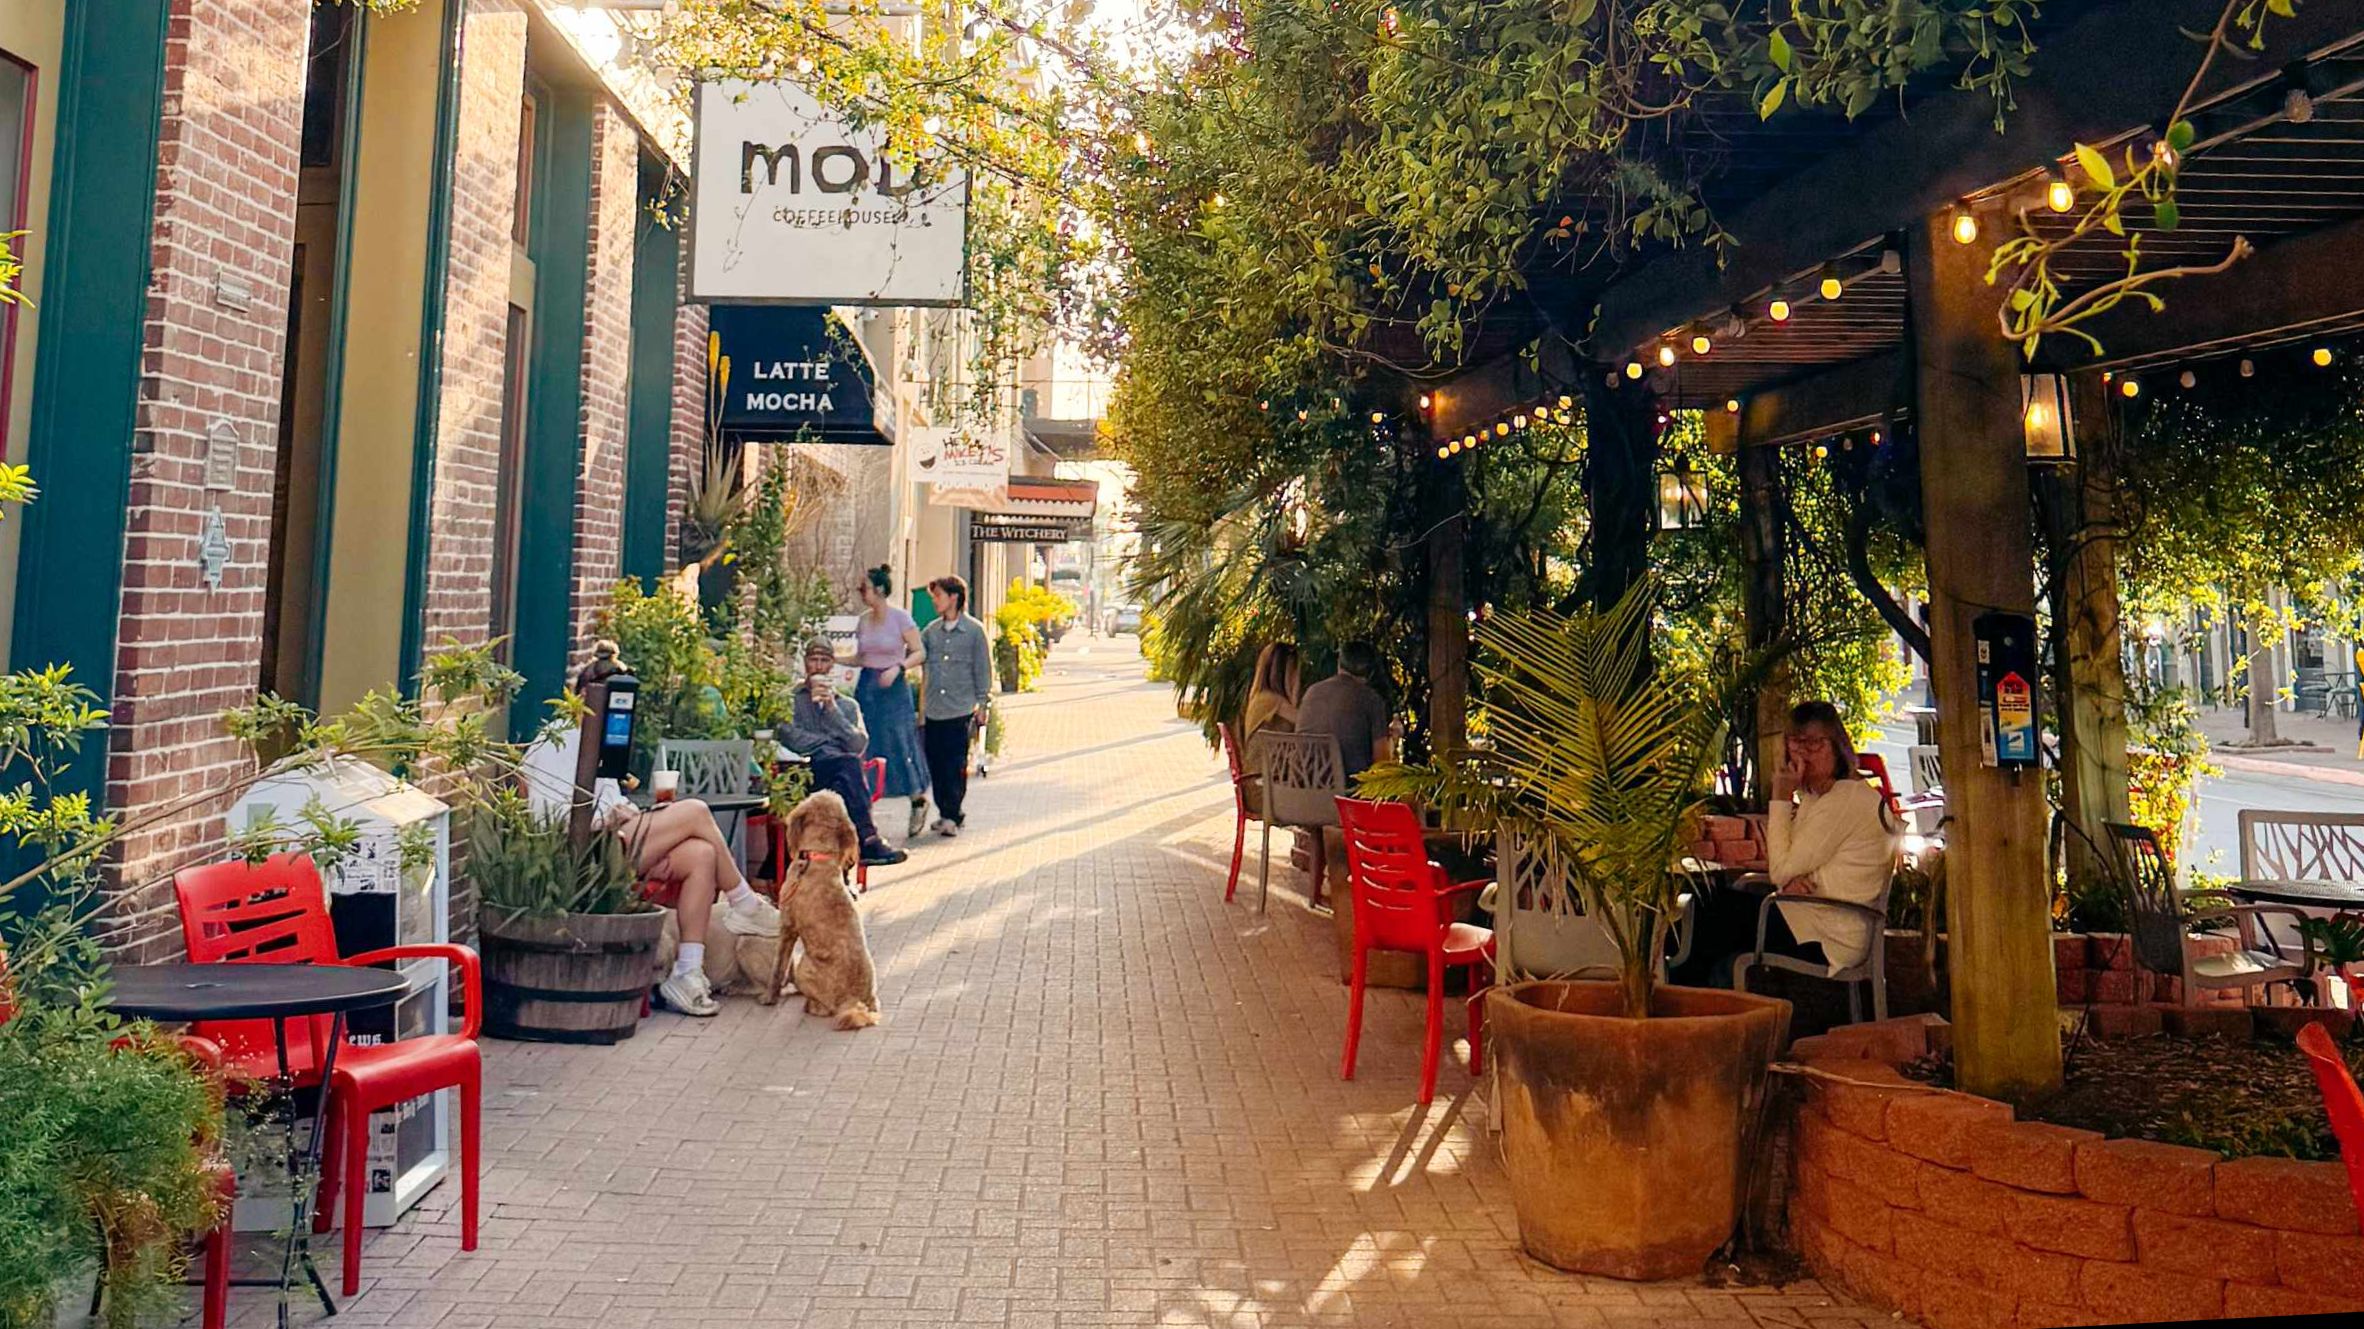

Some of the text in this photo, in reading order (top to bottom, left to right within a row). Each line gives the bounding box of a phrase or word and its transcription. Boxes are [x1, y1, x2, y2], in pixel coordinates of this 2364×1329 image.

[753, 361, 830, 380] LATTE
[746, 393, 835, 411] MOCHA
[972, 525, 1068, 540] THE WITCHERY
